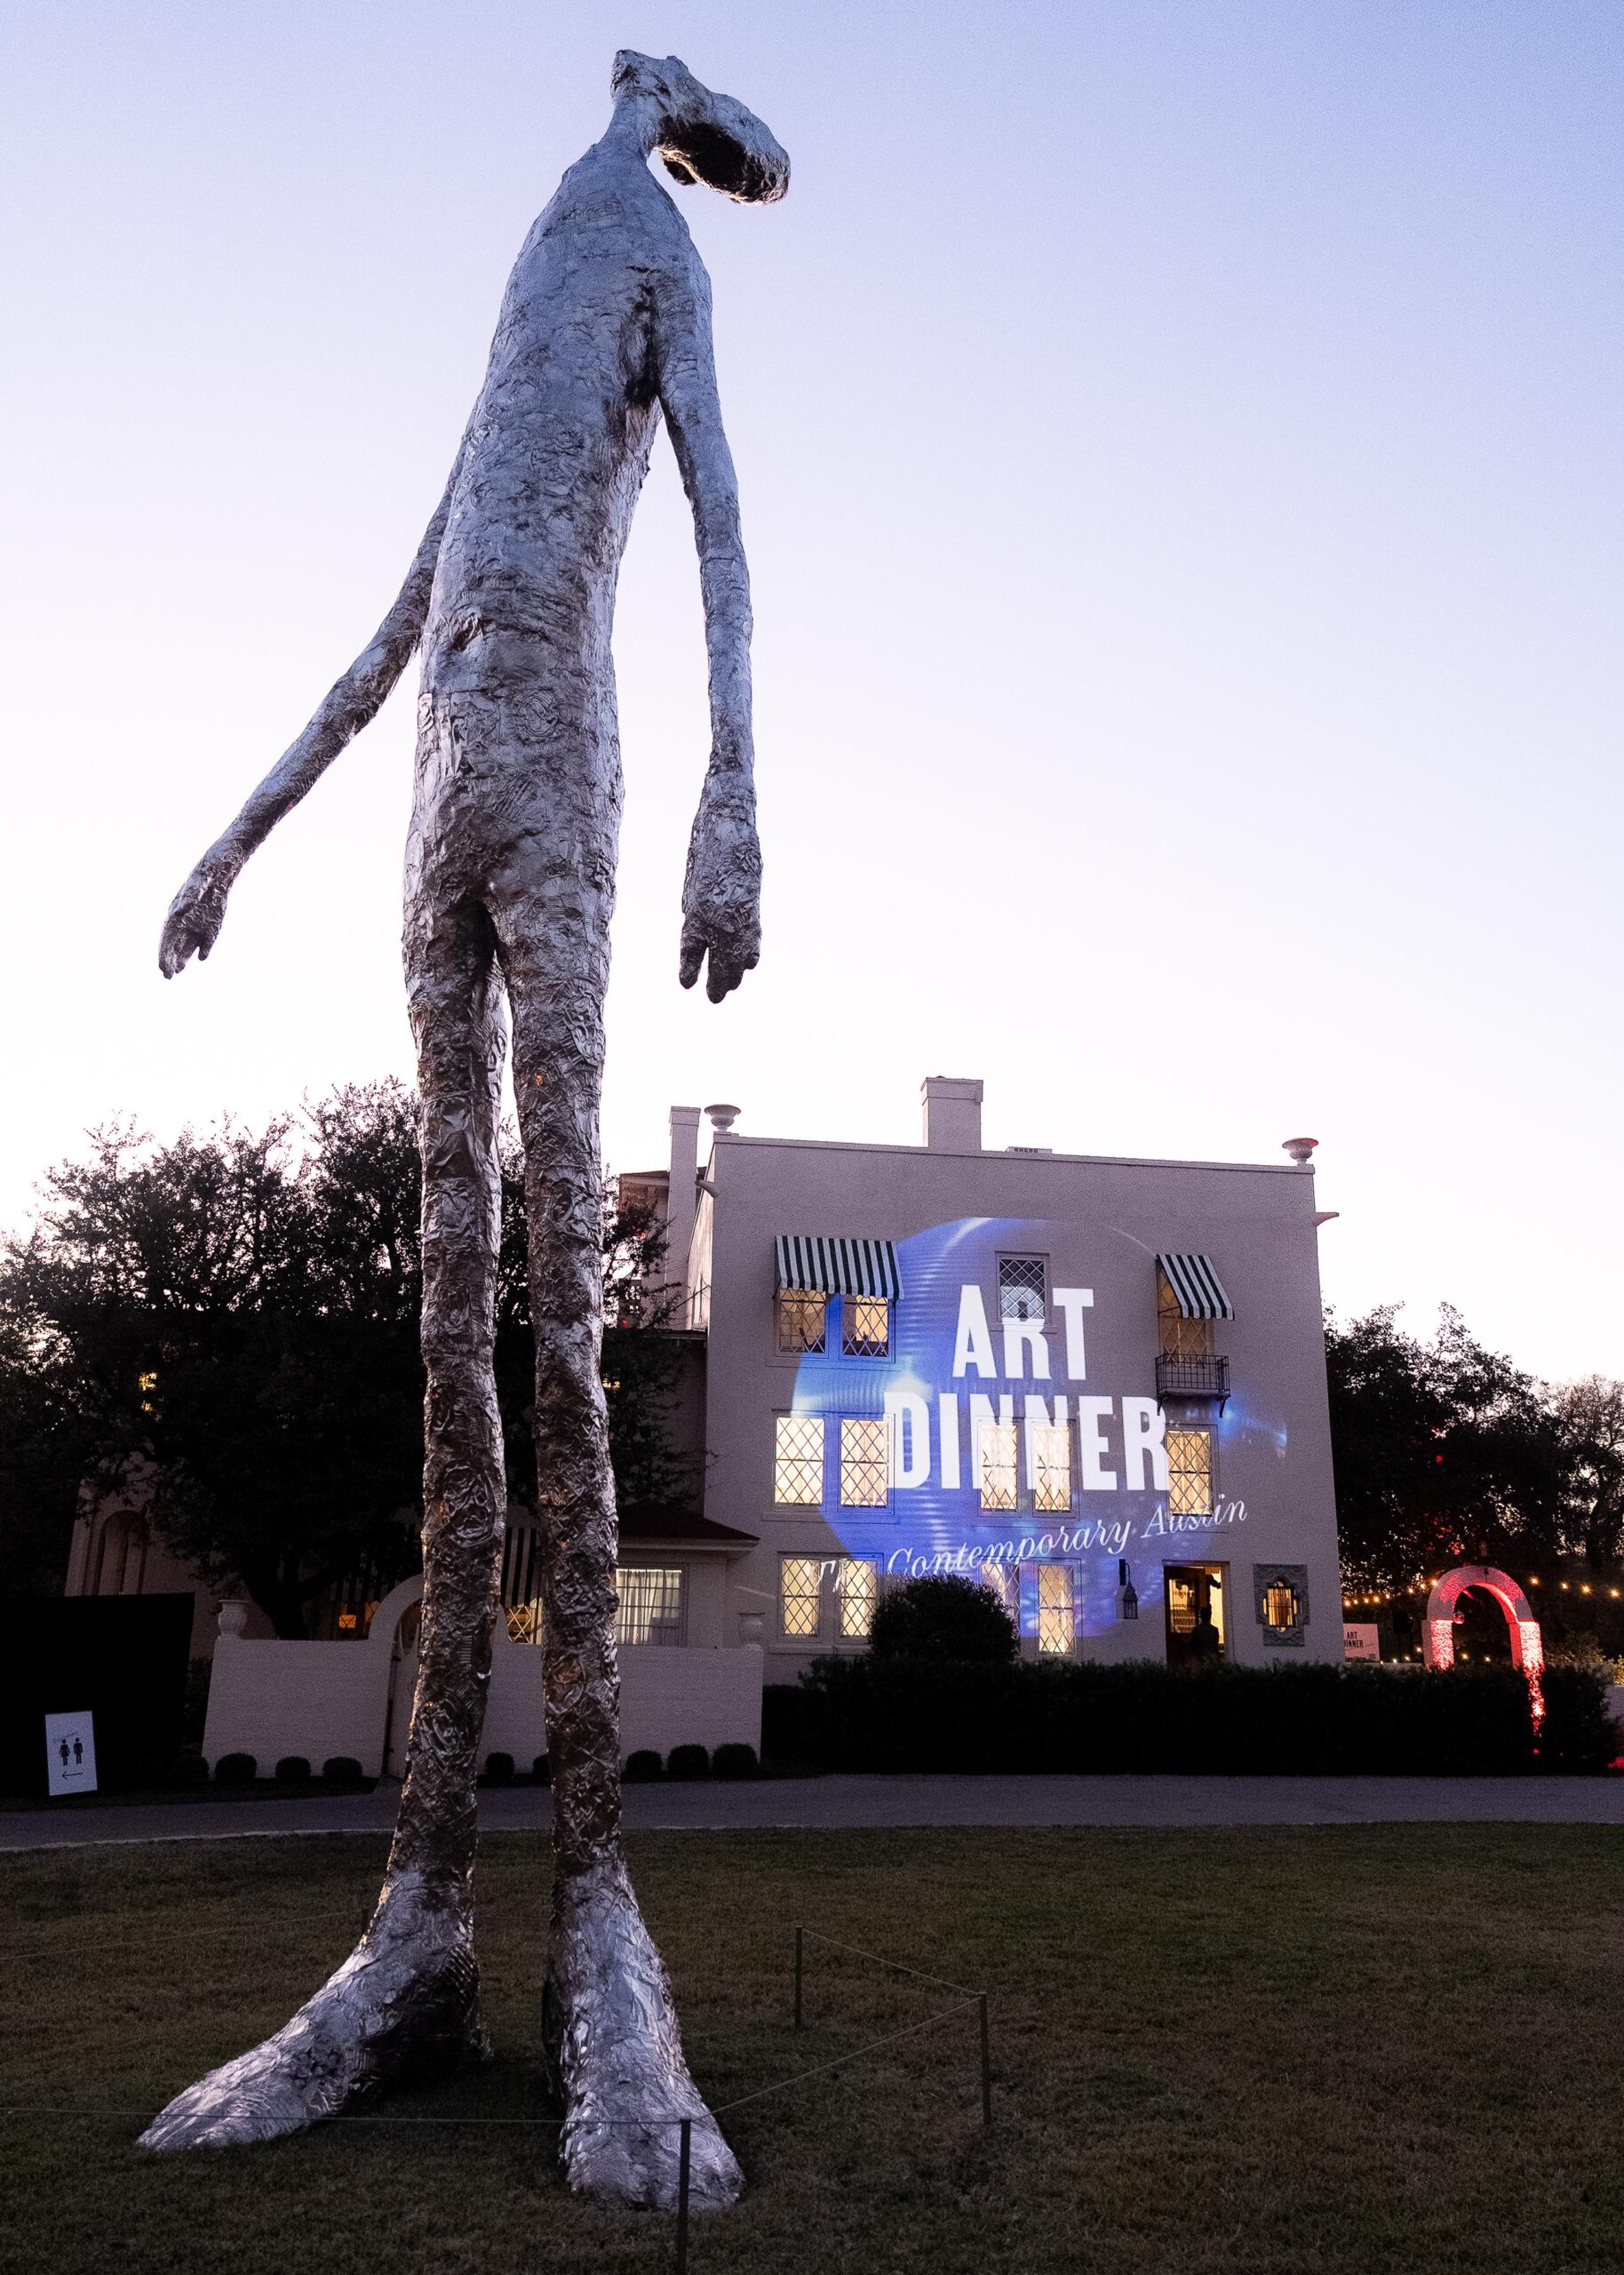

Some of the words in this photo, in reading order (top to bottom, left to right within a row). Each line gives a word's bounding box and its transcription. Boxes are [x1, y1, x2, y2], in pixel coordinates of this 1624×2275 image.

[952, 1285, 1094, 1380] ART
[883, 1392, 1170, 1491] DINNER
[888, 1520, 1132, 1577] Contemporary
